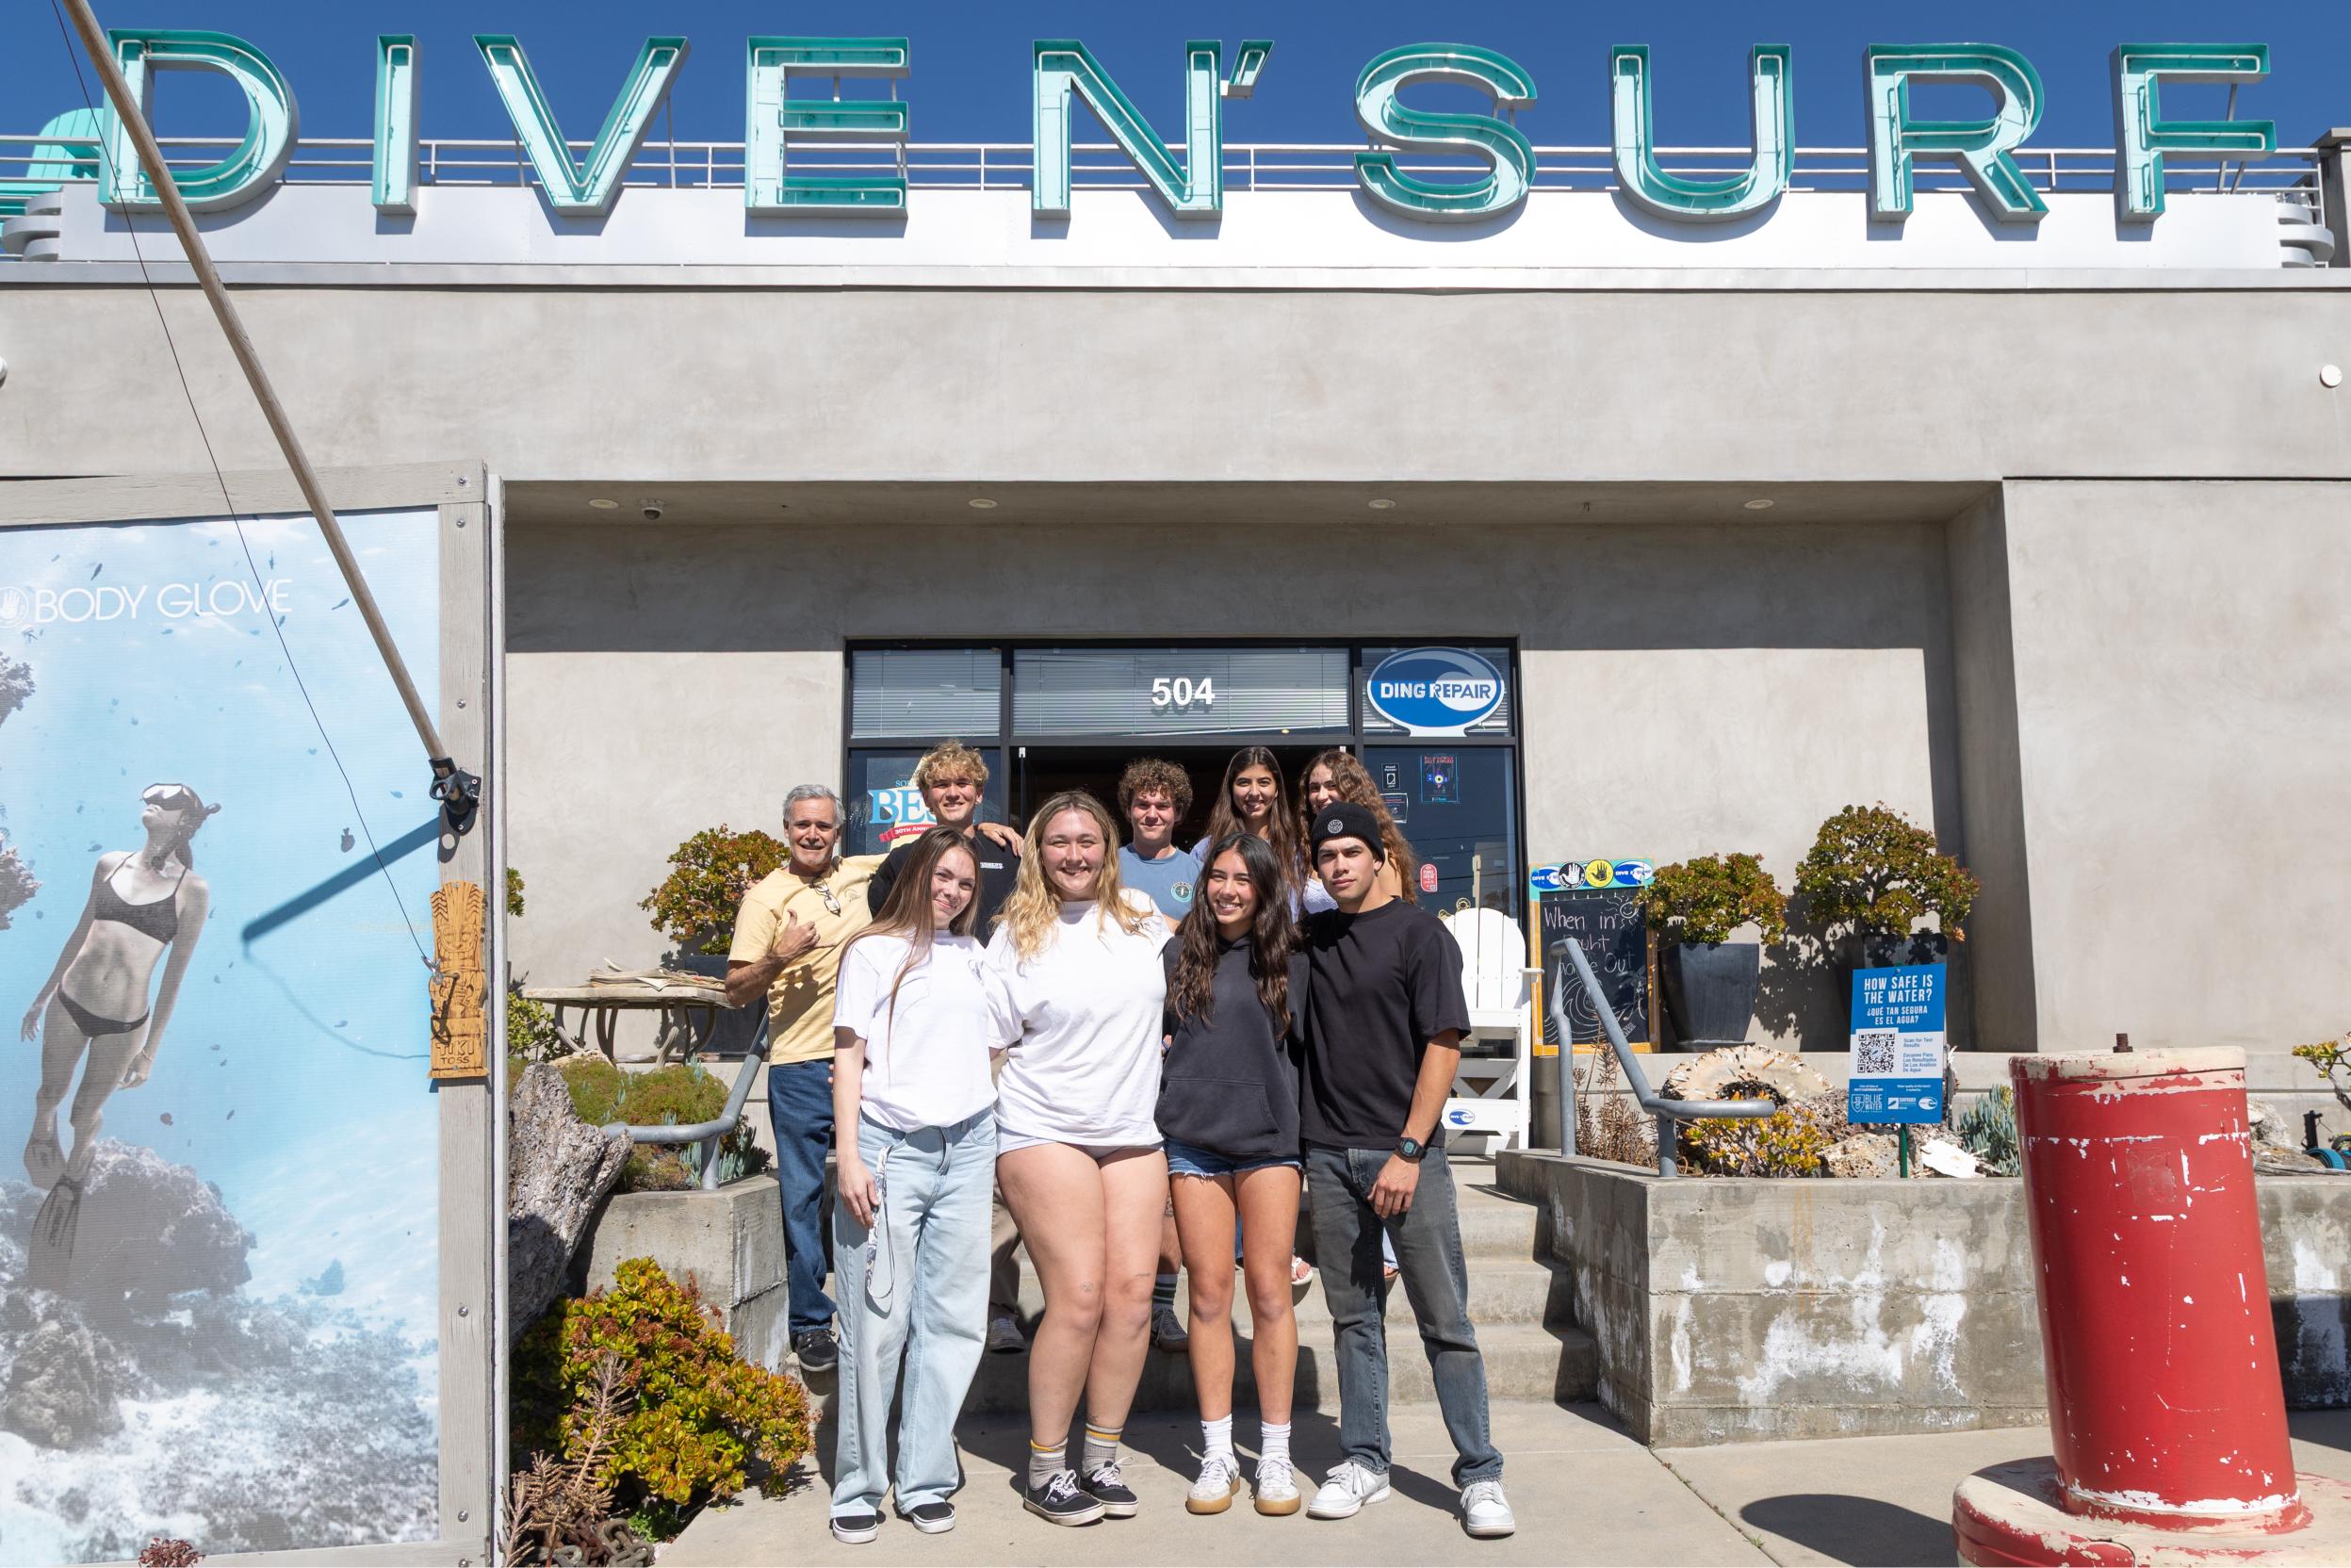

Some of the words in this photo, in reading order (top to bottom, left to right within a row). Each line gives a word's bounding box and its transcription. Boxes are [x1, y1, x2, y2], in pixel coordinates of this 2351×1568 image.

[98, 28, 909, 218] DIVE
[35, 584, 149, 623] BODY
[157, 579, 293, 618] GLOVE
[1151, 678, 1216, 706] 504
[1380, 682, 1426, 698] DING
[1429, 682, 1491, 699] REPAIR
[1544, 906, 1585, 930] When
[1604, 950, 1636, 973] Out
[1864, 977, 1887, 991] HOW
[1891, 974, 1918, 989] SAFE
[1922, 973, 1934, 988] IS
[1864, 991, 1884, 1004] THE
[1888, 988, 1933, 1004] WATER?
[1867, 1006, 1884, 1017] ¿QUÉ
[1902, 1005, 1928, 1015] SEGURA
[1875, 1017, 1884, 1025] ES
[1886, 1017, 1894, 1025] EL
[1896, 1015, 1919, 1024] AGUA?
[436, 1039, 474, 1055] TIKI
[440, 1056, 469, 1065] TOSS
[1865, 1094, 1883, 1102] BLUE
[1865, 1102, 1883, 1111] WATER
